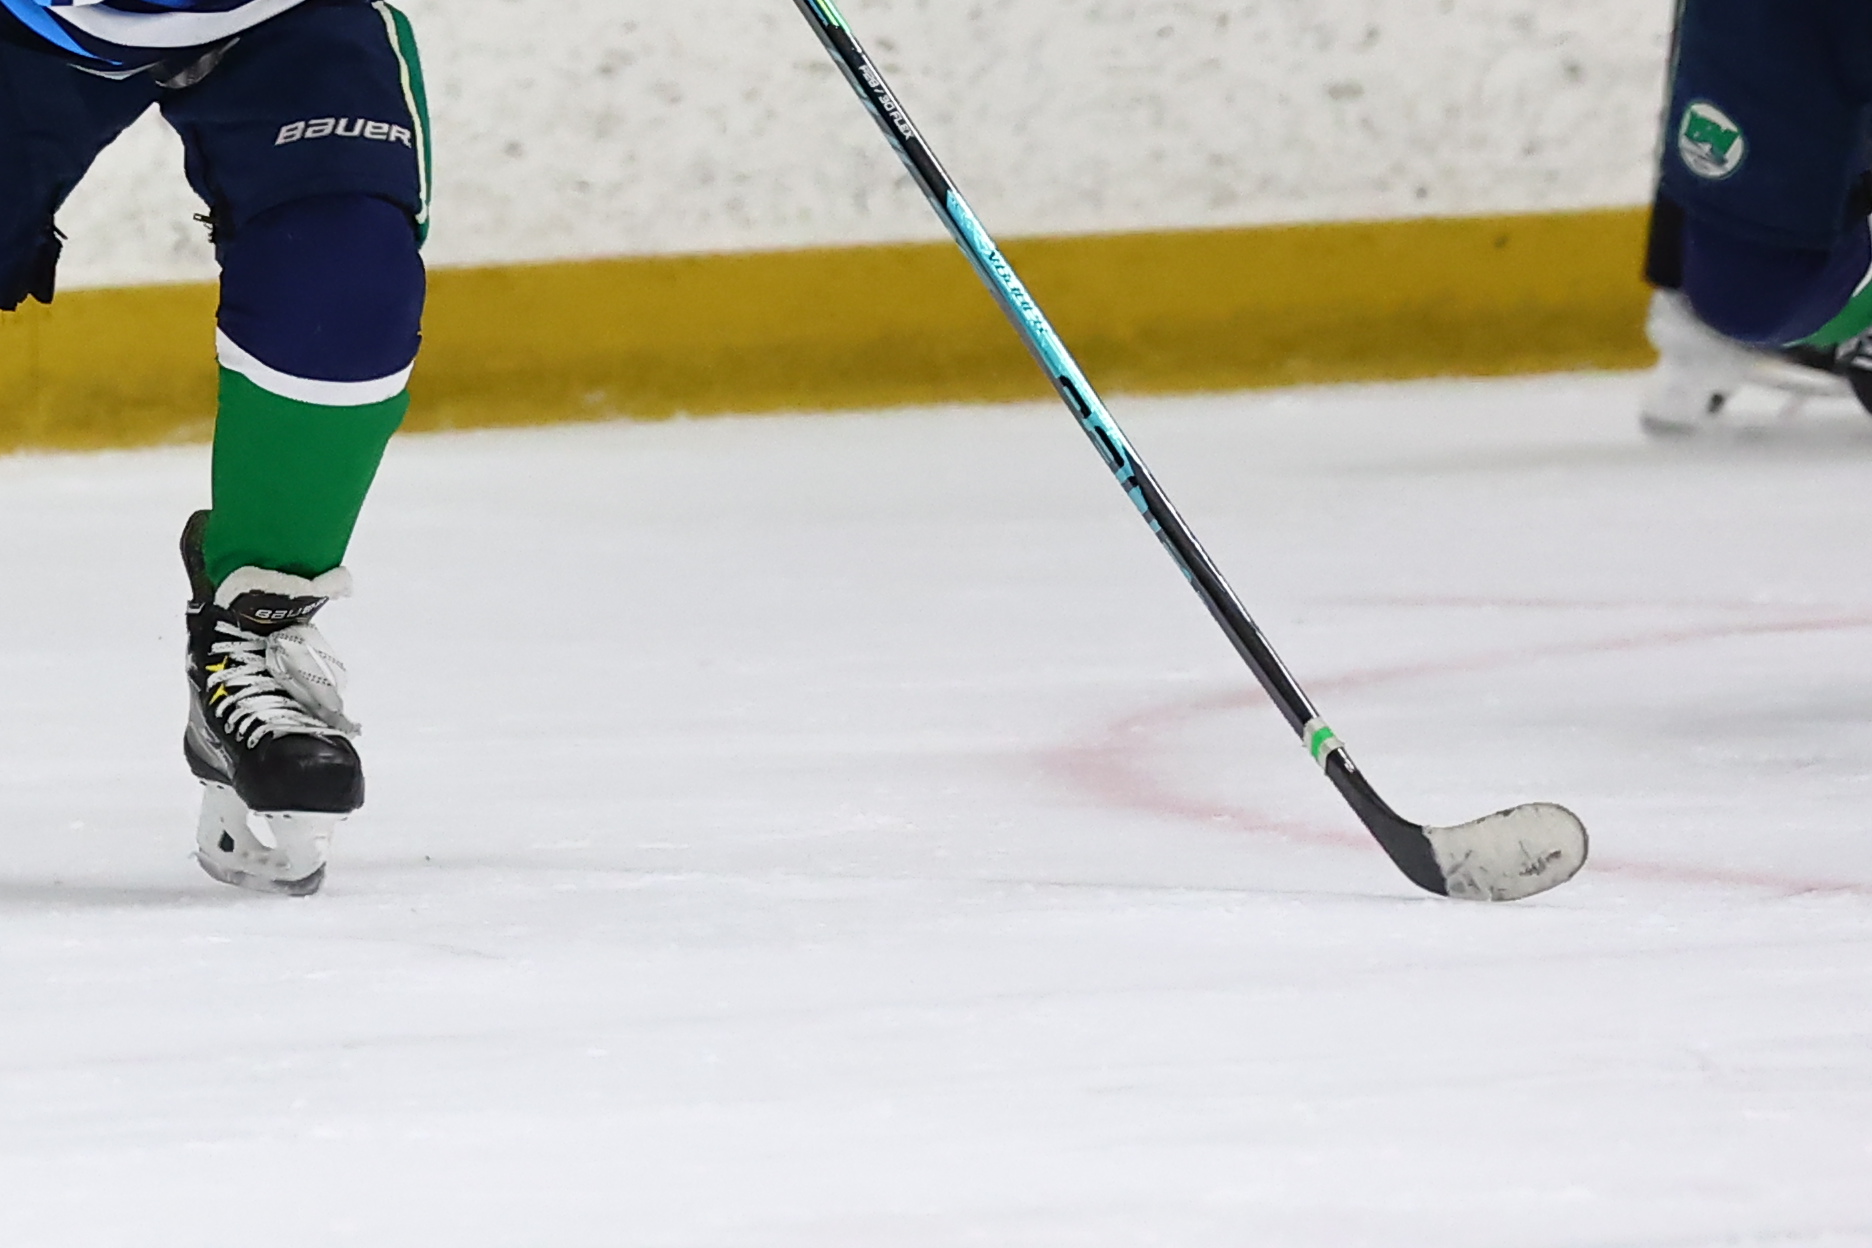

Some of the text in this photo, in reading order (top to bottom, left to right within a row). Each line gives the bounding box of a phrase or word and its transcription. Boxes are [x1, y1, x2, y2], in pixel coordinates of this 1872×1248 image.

[858, 65, 879, 88] P28
[890, 112, 914, 140] FLEX
[274, 117, 412, 149] BAUER
